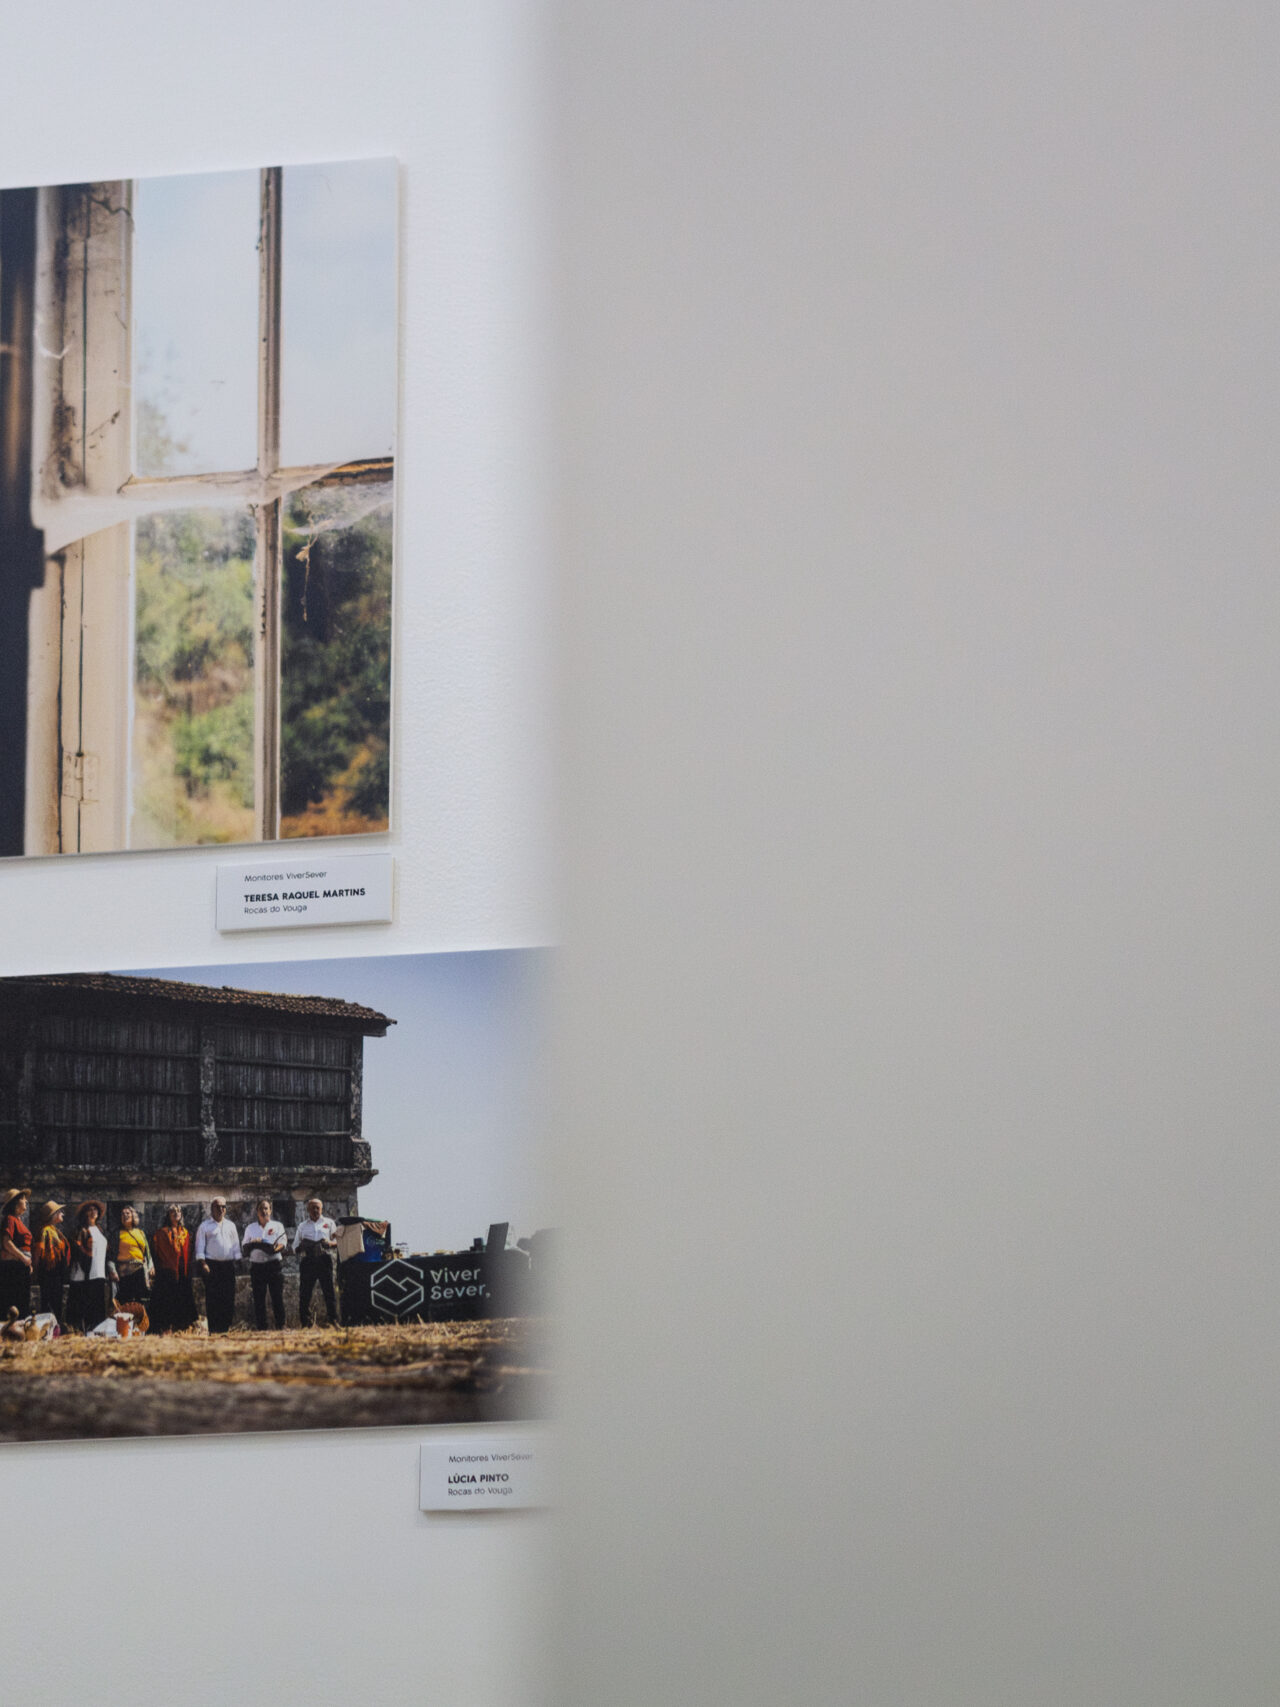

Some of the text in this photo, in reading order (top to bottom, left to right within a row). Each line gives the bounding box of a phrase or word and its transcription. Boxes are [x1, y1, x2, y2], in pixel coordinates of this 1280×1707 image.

[244, 871, 327, 882] Monitores ViverSever
[244, 888, 366, 902] TERESA RAQUEL MARTINS
[244, 906, 267, 914] Rocas
[283, 904, 307, 912] Vouga
[430, 1267, 481, 1283] Viver
[449, 1455, 488, 1463] Monitores
[448, 1473, 509, 1483] LÚCIA PINTO
[488, 1487, 513, 1495] Vouga
